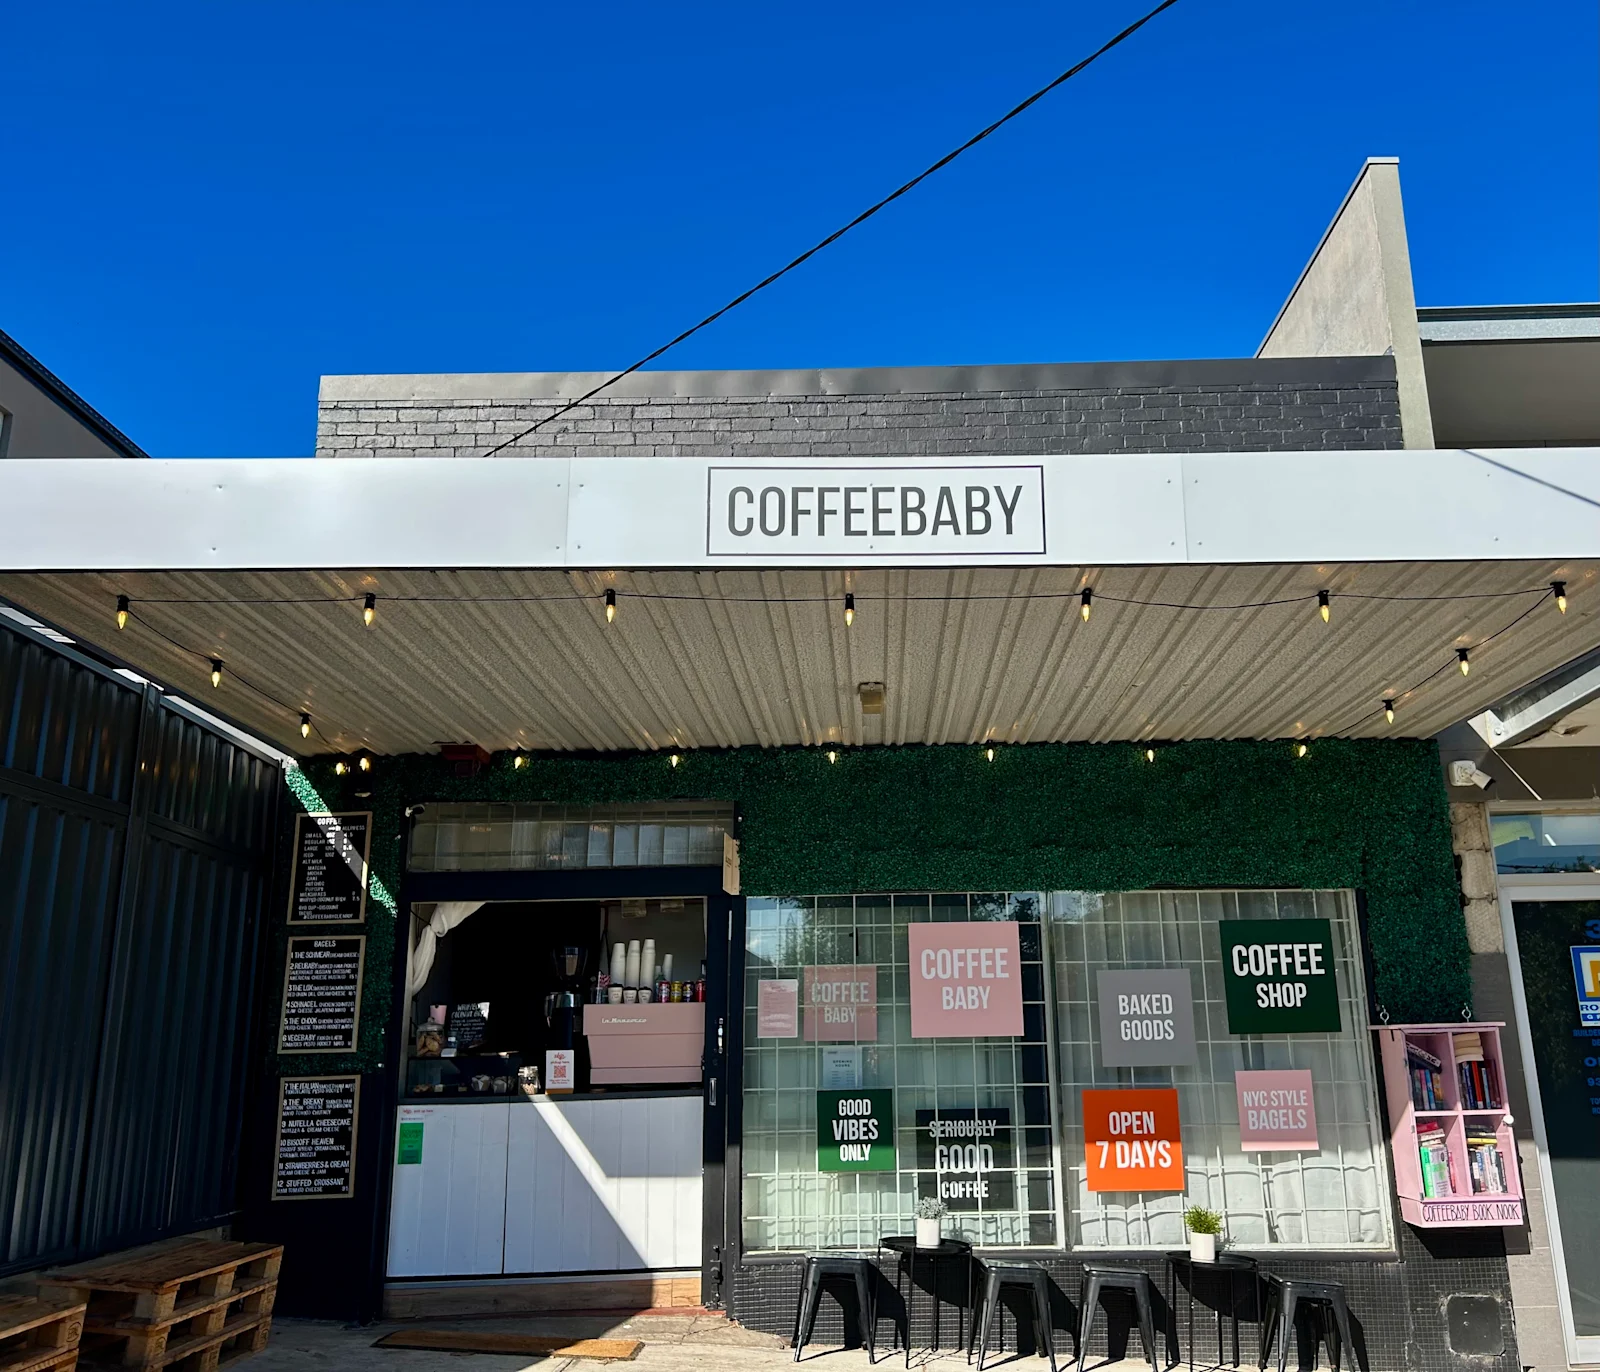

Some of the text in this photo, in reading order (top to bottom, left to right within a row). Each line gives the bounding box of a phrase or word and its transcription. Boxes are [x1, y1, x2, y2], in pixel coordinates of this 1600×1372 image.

[727, 485, 1023, 537] COFFEEBABY
[314, 940, 337, 948] BAGELS
[921, 948, 1010, 979] COFFEE
[1231, 943, 1326, 977] COFFEE
[811, 982, 870, 1003] COFFEE
[942, 985, 991, 1010] BABY
[1256, 982, 1308, 1008] SHOP
[1118, 994, 1173, 1015] BAKED
[824, 1006, 857, 1024] BABY
[1120, 1019, 1175, 1041] GOODS
[288, 1098, 300, 1106] THE
[838, 1099, 872, 1116] GOOD
[1243, 1090, 1308, 1107] NYC STYLE
[288, 1119, 315, 1128] NUTELLA
[315, 1117, 351, 1127] CHEESECAKE
[832, 1118, 879, 1141] VIBES
[928, 1119, 997, 1138] SERIOUSLY
[1108, 1111, 1155, 1135] OPEN
[1248, 1109, 1308, 1130] BAGELS
[310, 1137, 335, 1146] HEAVEN
[839, 1143, 872, 1162] ONLY
[935, 1144, 994, 1174] GOOD
[1095, 1140, 1172, 1169] 7 DAYS
[329, 1159, 350, 1169] CREAM
[285, 1179, 312, 1188] STUFFED
[313, 1177, 345, 1187] CROISSANT
[940, 1180, 989, 1199] COFFEE
[1422, 1203, 1521, 1222] COFFEEBABY BOOK NOOK
